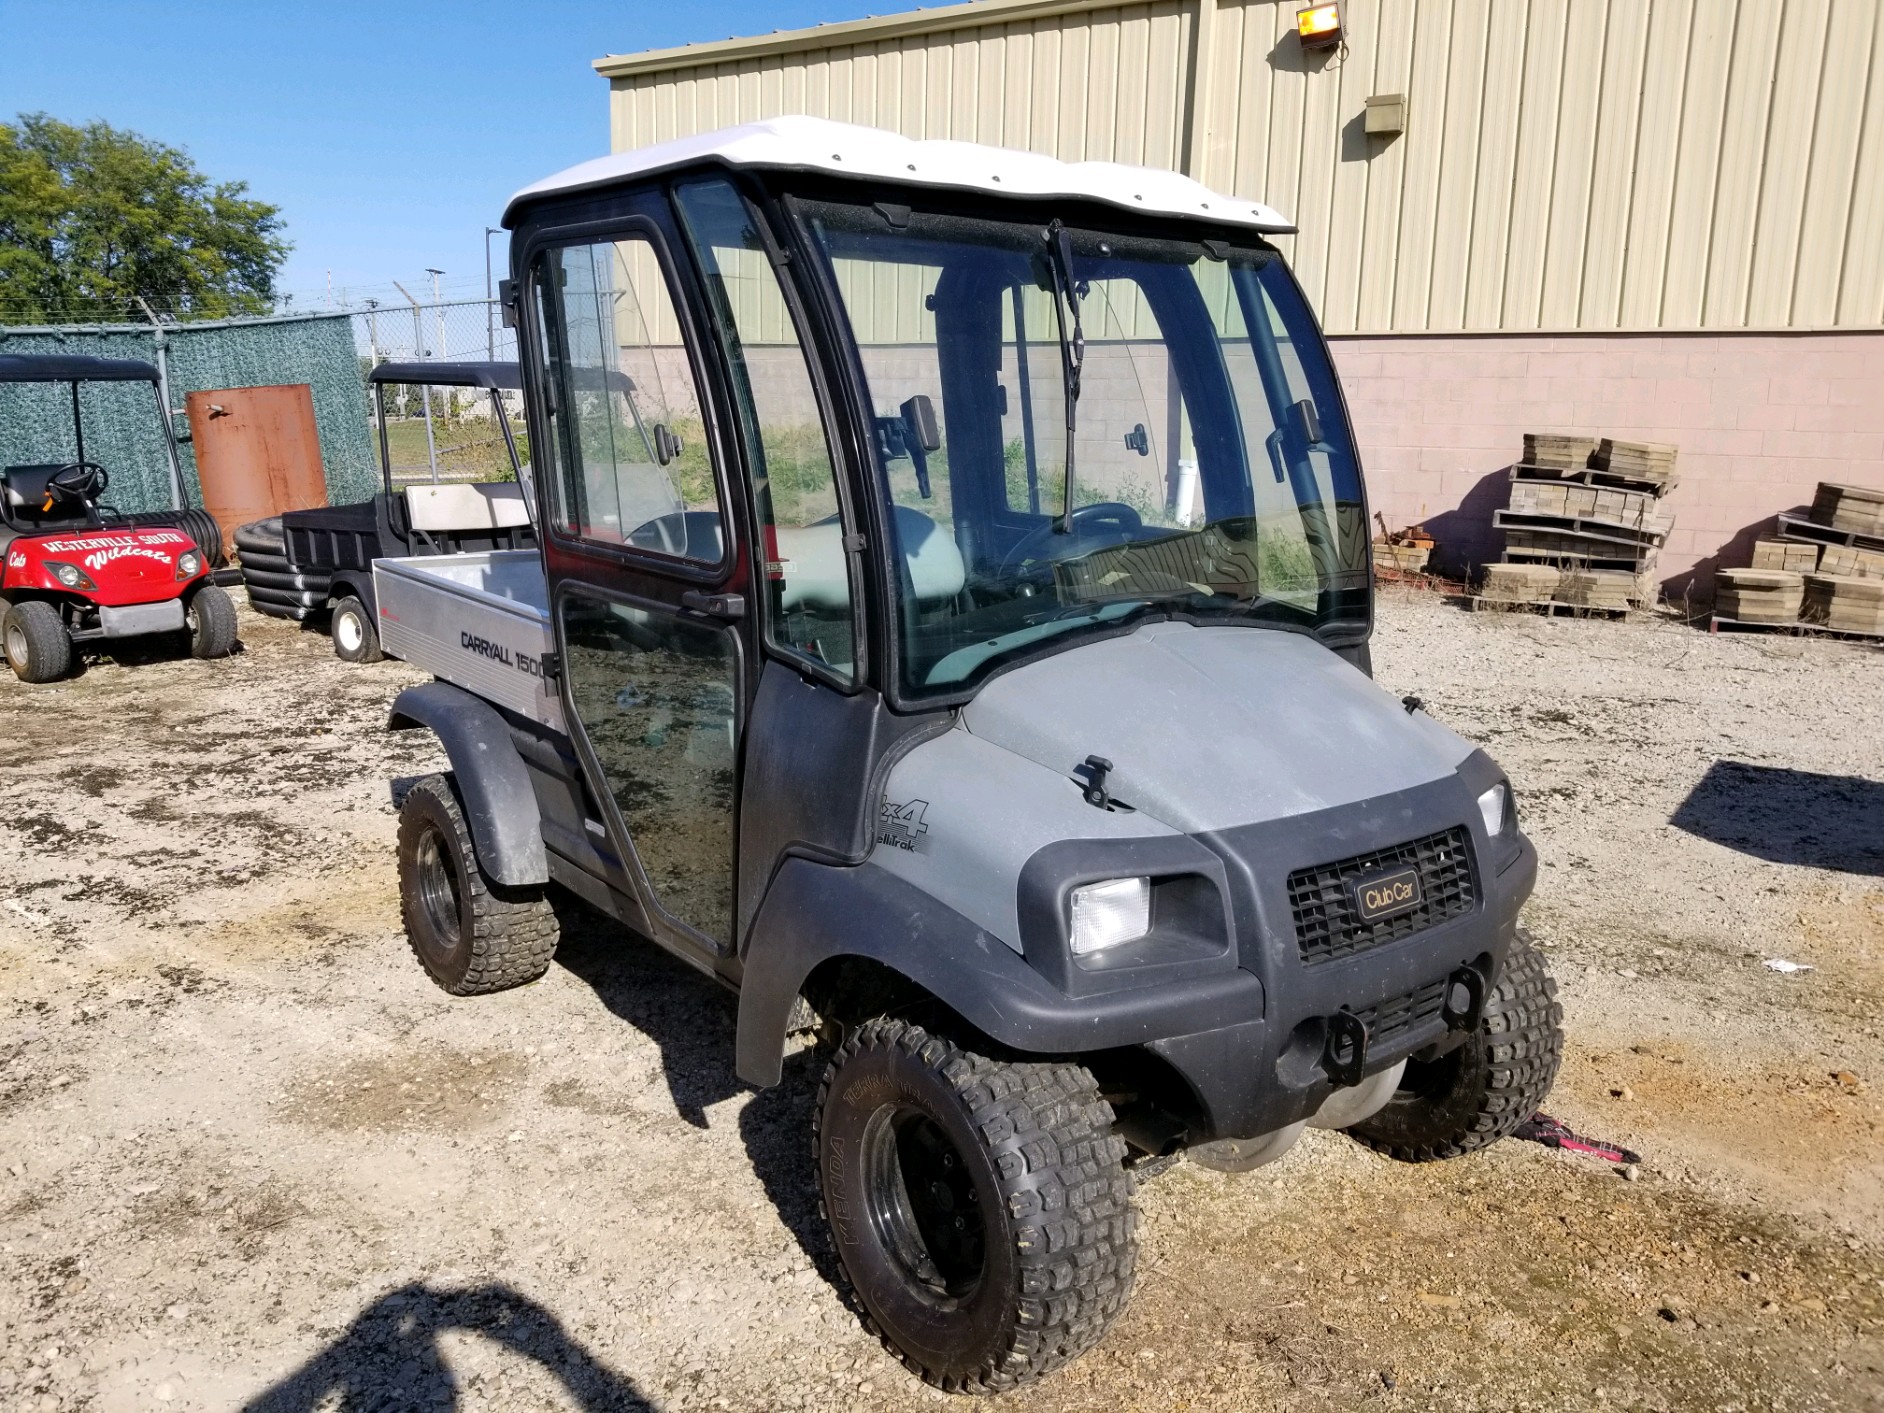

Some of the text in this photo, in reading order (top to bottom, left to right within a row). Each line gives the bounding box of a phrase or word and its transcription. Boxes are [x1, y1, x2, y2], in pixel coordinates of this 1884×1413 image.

[42, 533, 184, 553] WESTERVILLE SOUTH
[85, 546, 172, 570] Wildcats
[461, 630, 513, 667] CARRYALL
[880, 795, 929, 838] x4
[1366, 882, 1413, 909] Club Car
